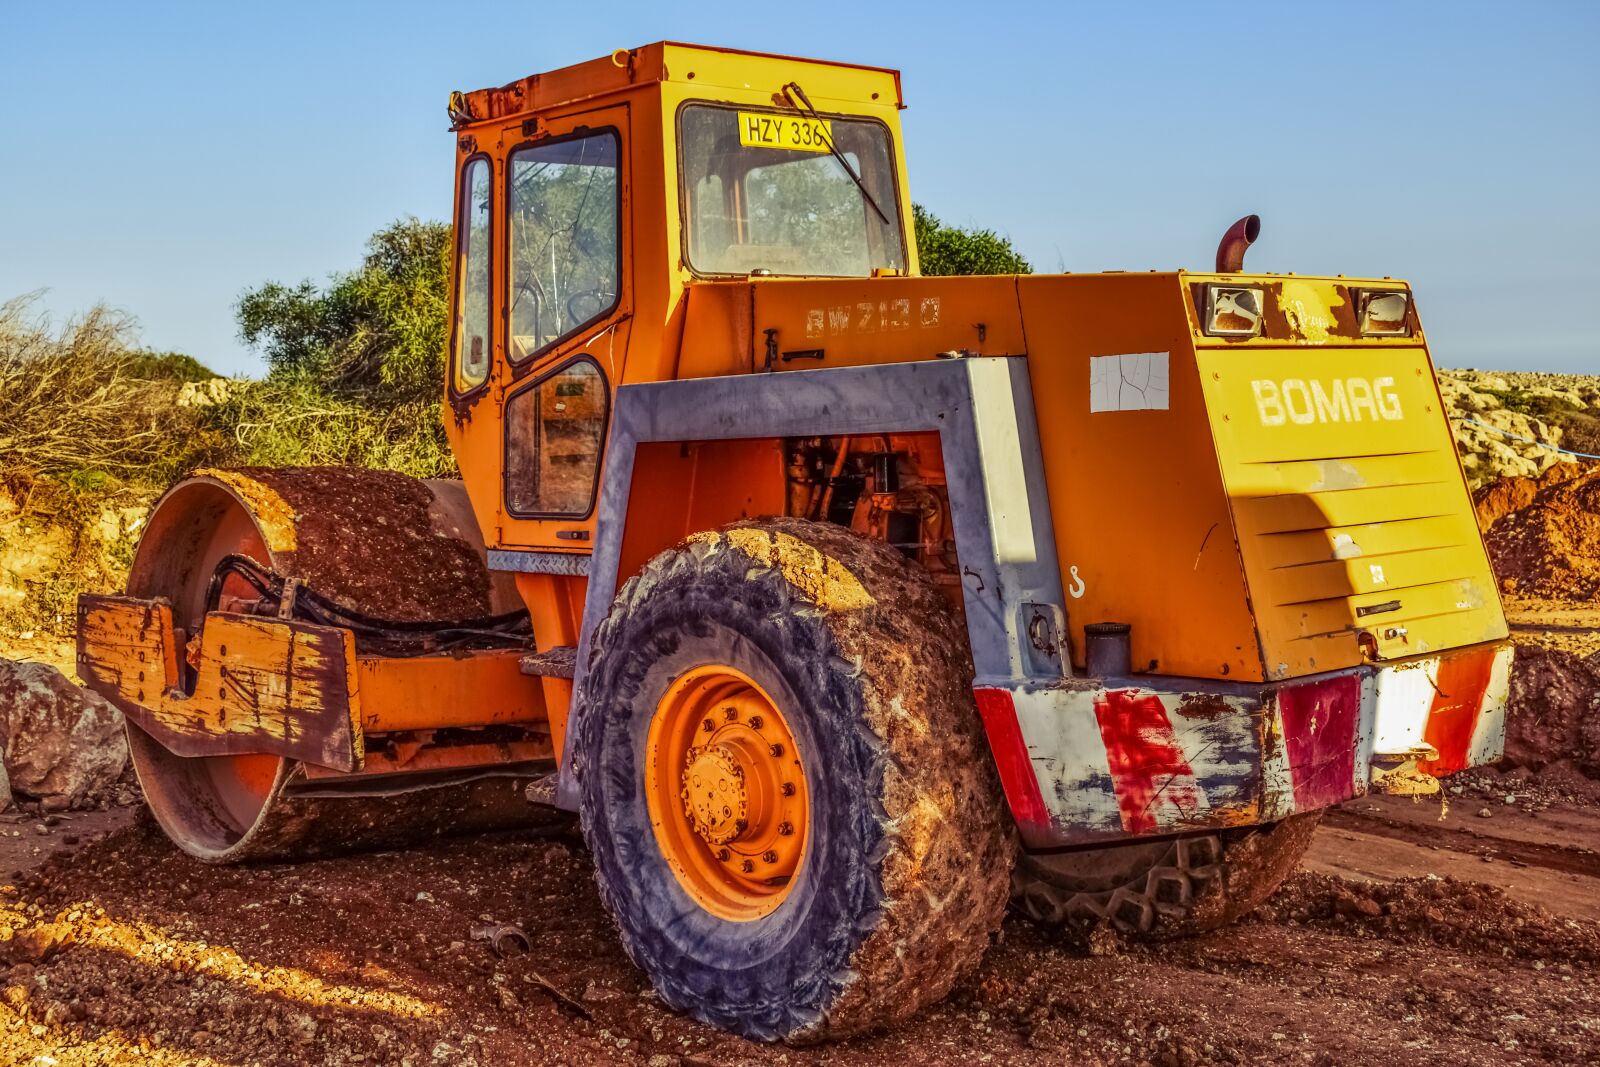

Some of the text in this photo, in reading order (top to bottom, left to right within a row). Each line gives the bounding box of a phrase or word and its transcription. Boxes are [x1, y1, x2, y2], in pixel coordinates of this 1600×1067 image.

[747, 117, 823, 147] HZY 336
[1250, 376, 1404, 427] BOMAG
